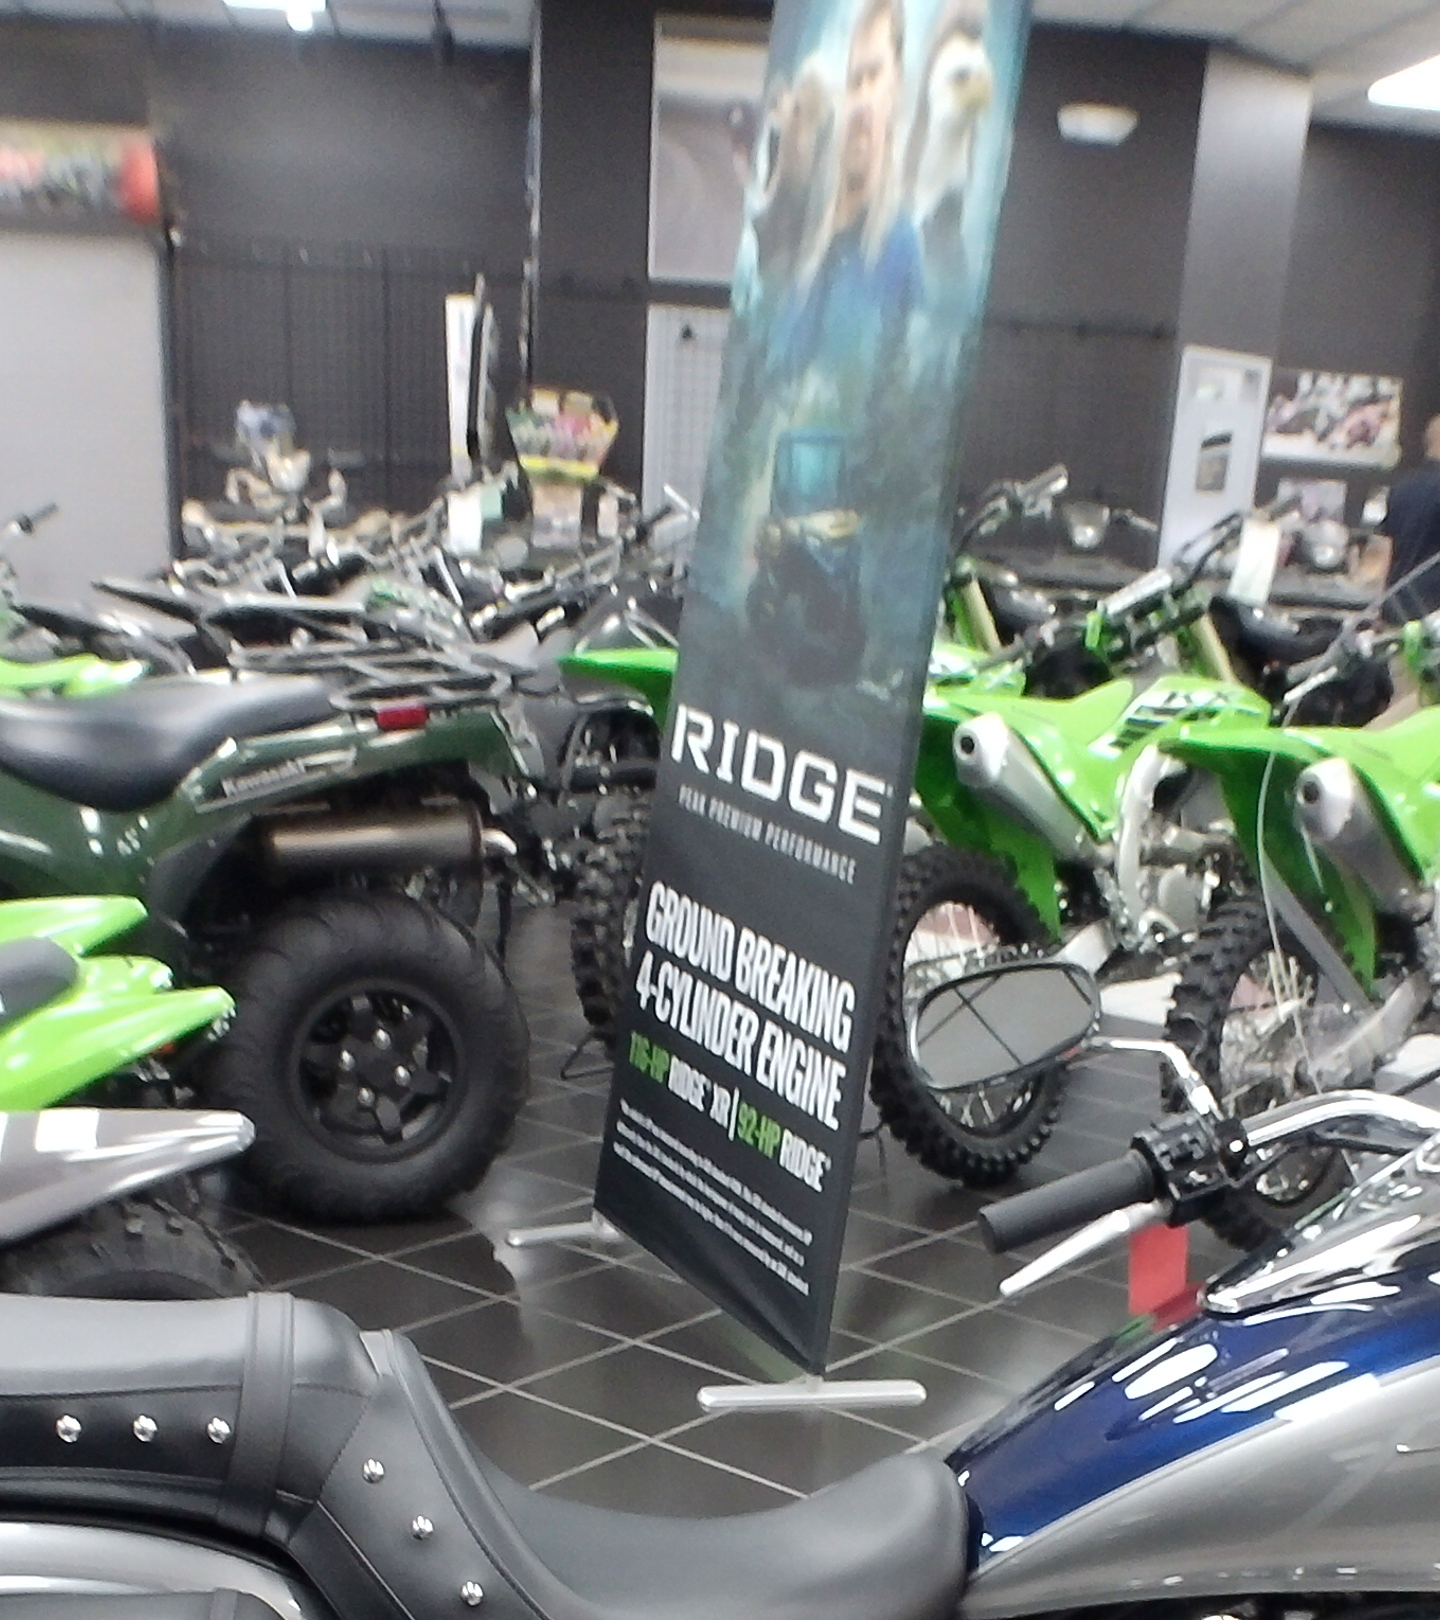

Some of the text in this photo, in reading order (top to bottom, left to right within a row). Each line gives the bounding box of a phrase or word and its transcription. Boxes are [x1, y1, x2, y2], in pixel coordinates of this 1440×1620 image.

[671, 703, 890, 845] RIDGE
[635, 949, 847, 1132] 4-CYLINDER ENGINE
[645, 880, 856, 1053] GROUND BREAKING
[737, 1101, 781, 1160] 92-HP
